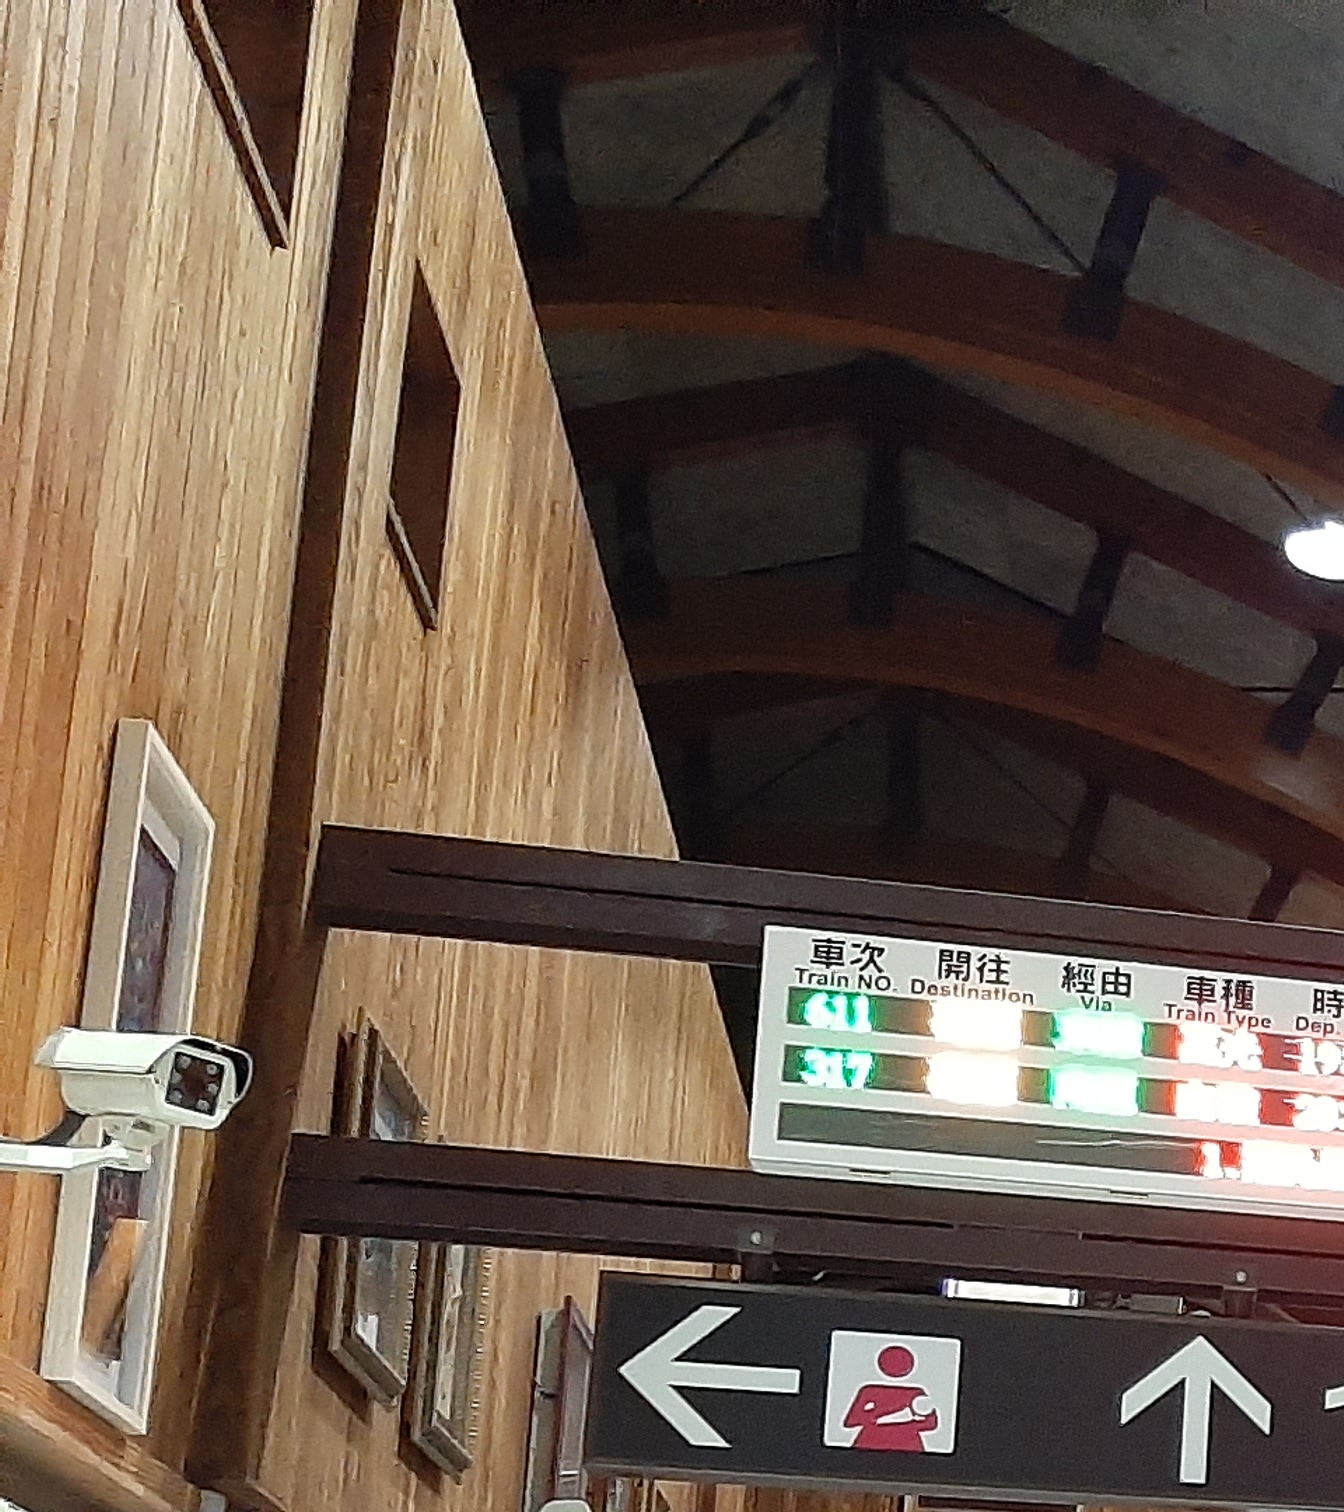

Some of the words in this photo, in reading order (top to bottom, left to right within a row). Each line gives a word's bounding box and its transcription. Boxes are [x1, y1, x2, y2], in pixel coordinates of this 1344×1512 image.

[794, 967, 849, 987] Train
[910, 978, 1034, 1005] Destination
[1078, 996, 1112, 1012] Via
[1163, 1003, 1215, 1024] Train
[1223, 1010, 1272, 1030] Type
[1296, 1015, 1341, 1036] Dep.
[810, 938, 886, 974] 車次
[938, 949, 1010, 985] 開往
[1061, 962, 1133, 998] 經由
[1184, 975, 1254, 1012] 車種
